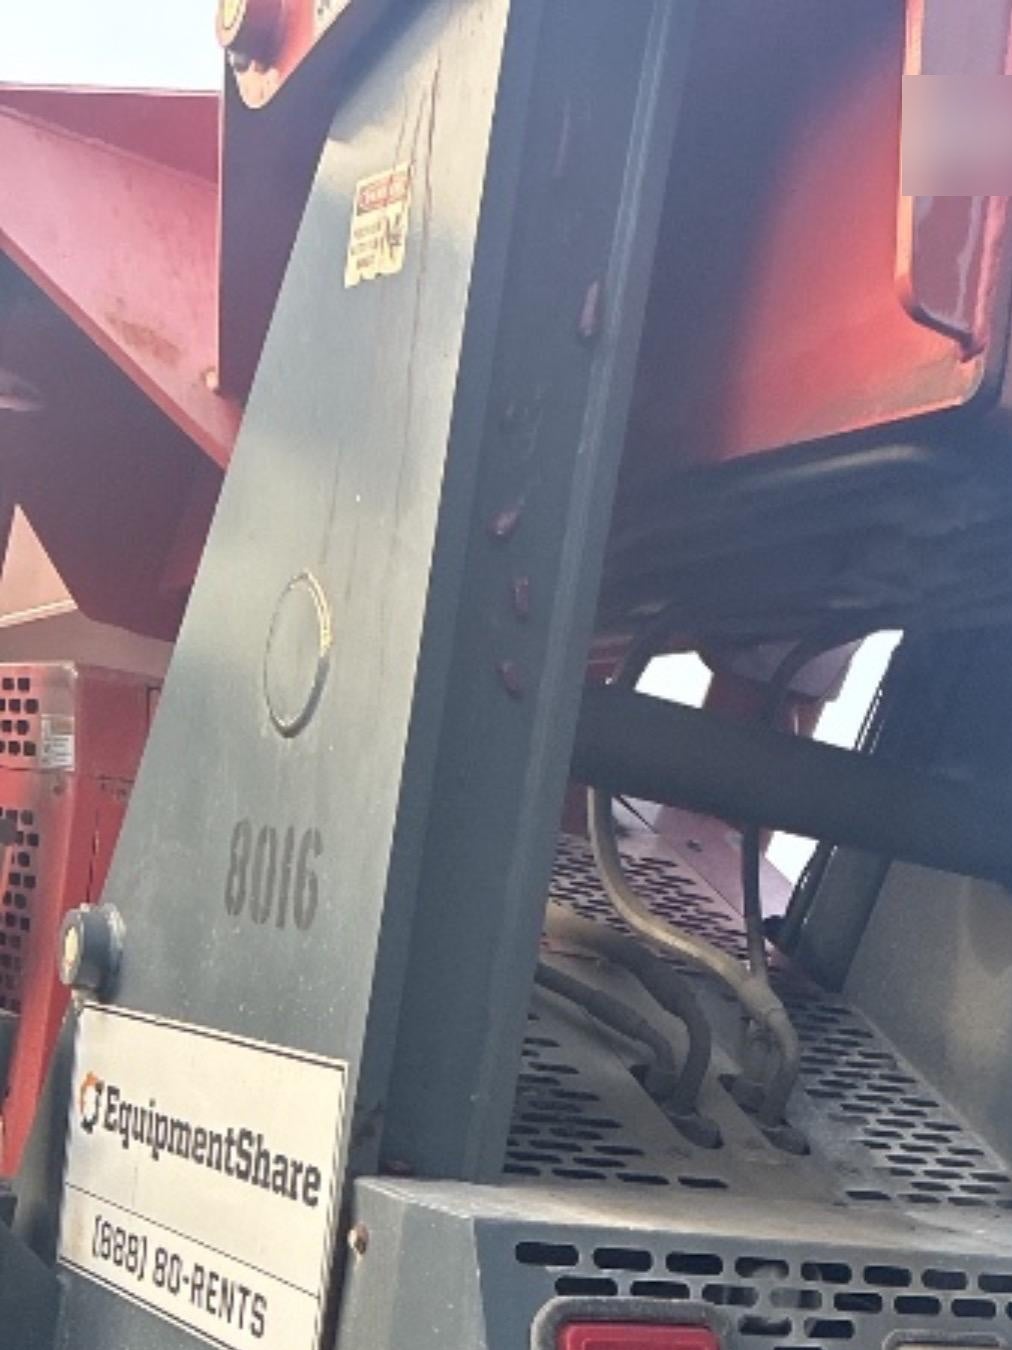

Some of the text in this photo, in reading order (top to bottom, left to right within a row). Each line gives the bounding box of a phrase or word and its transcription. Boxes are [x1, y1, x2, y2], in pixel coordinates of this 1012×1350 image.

[224, 817, 324, 931] 8016
[102, 1084, 322, 1208] EquipmentShare
[91, 1214, 269, 1340] (888) 80-RENTS
